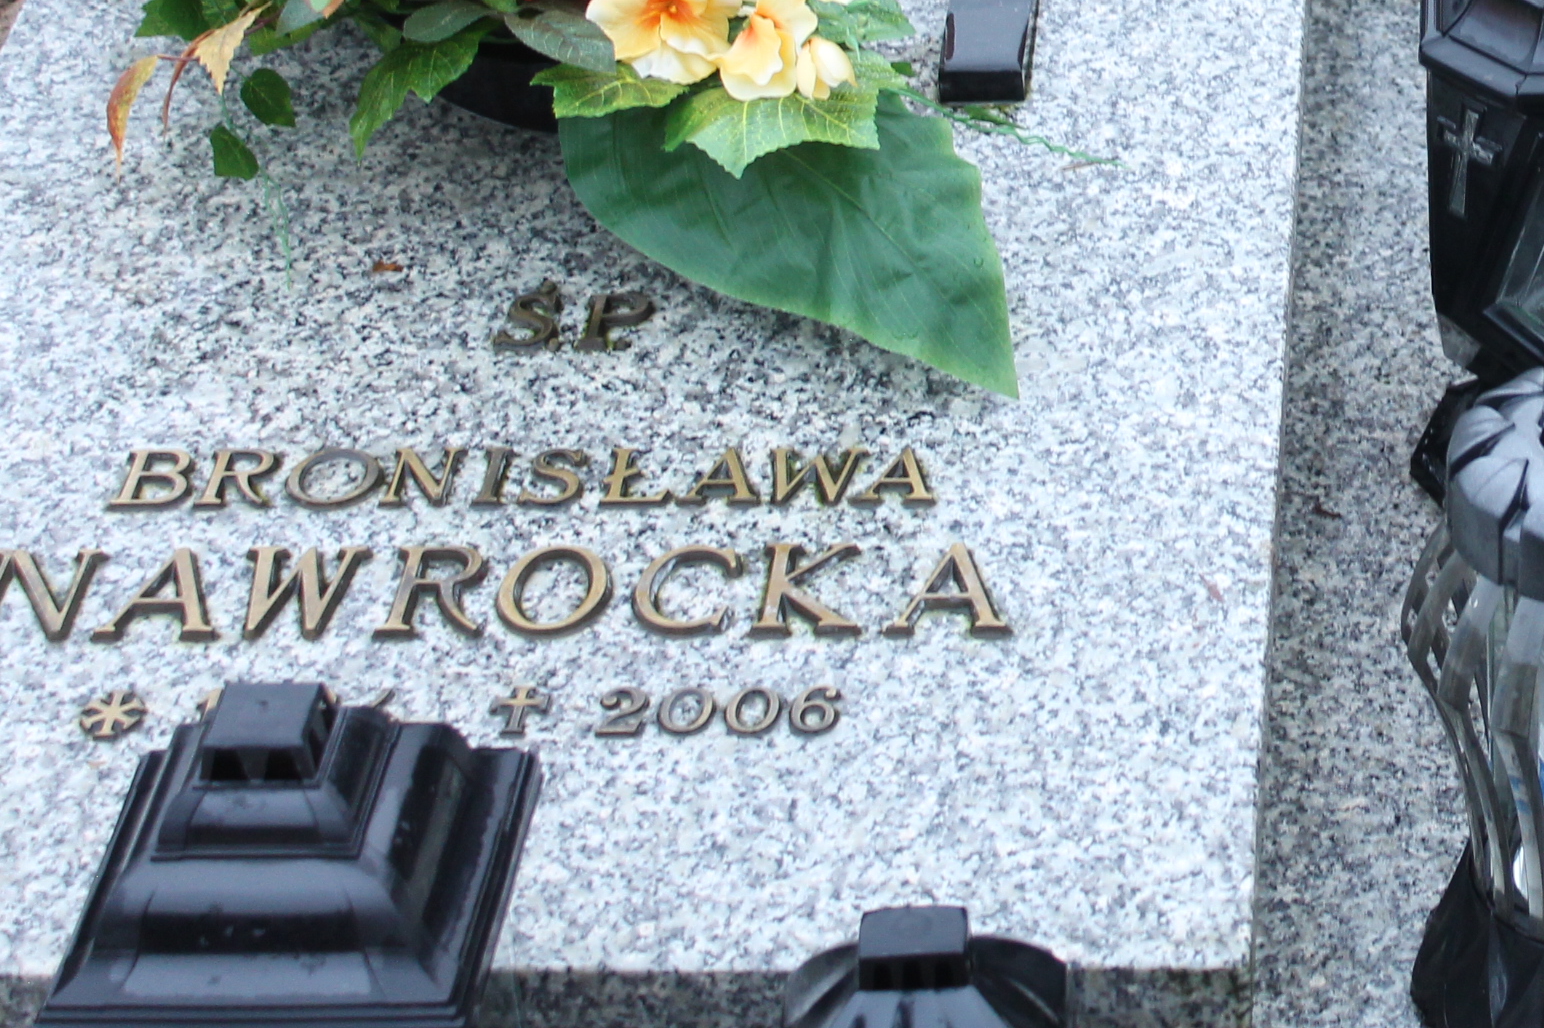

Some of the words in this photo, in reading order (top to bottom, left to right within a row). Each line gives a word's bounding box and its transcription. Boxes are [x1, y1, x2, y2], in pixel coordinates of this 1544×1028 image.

[106, 446, 937, 510] BRONISŁAWA
[0, 542, 1014, 641] NAWROCKA
[596, 685, 843, 737] 2006
